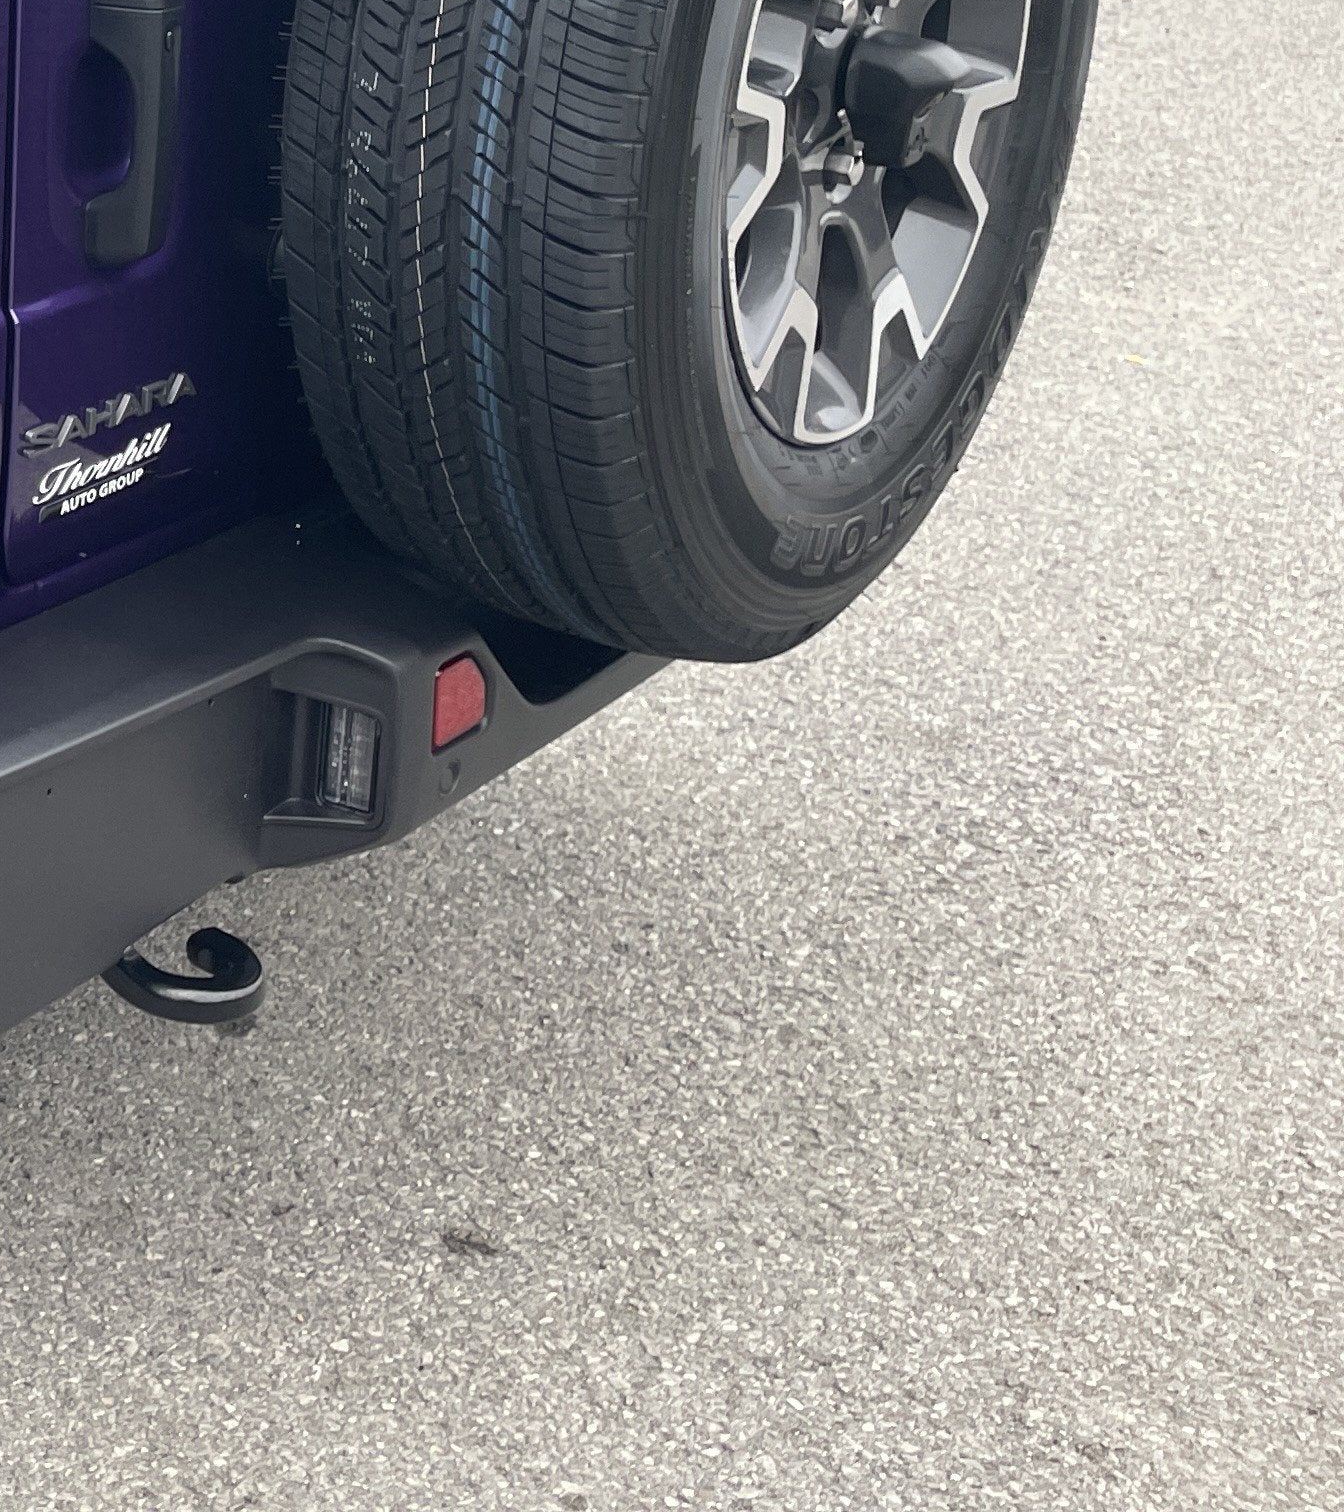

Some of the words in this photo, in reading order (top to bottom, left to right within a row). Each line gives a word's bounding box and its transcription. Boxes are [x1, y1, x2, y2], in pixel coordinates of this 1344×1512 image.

[20, 371, 198, 458] SAHARA
[31, 422, 172, 506] Thornhill
[60, 488, 97, 516] AUTO
[98, 467, 145, 499] GROUP
